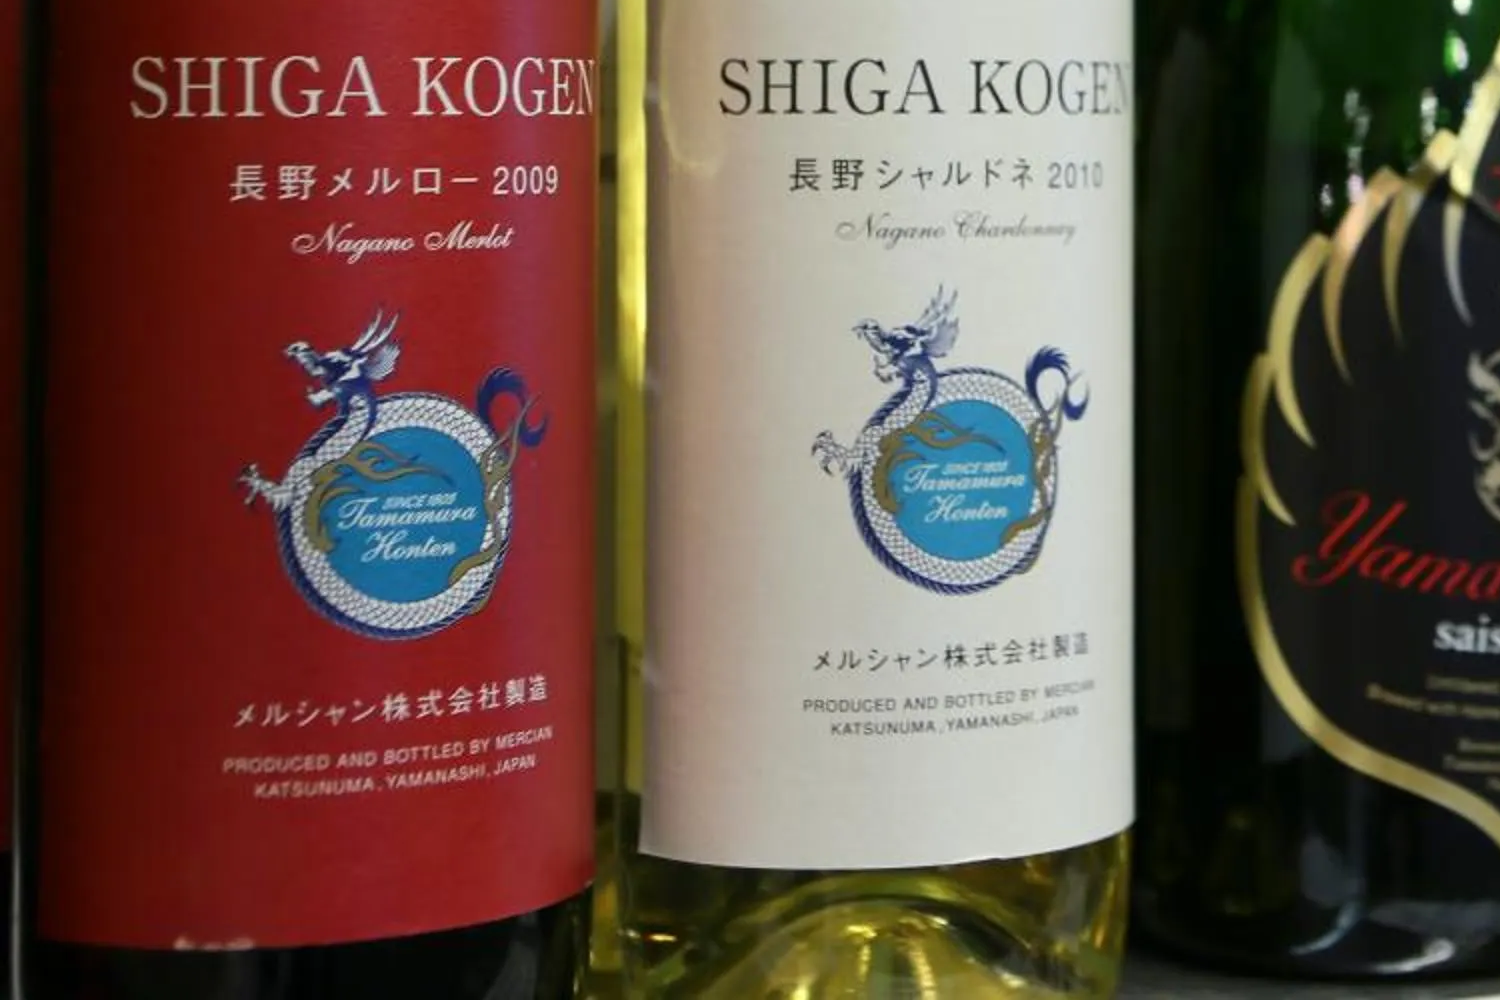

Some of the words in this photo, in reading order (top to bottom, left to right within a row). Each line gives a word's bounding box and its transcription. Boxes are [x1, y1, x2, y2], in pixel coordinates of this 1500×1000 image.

[130, 55, 386, 120] SHIGA
[412, 55, 596, 117] KOGEN
[718, 57, 949, 117] SHIGA
[968, 58, 1132, 117] KOGEN
[229, 163, 480, 202] 長野メルロー
[492, 165, 560, 197] 2009
[788, 157, 1035, 193] 長野シャルドネ
[1046, 160, 1104, 191] 2010
[290, 222, 415, 265] Nagano
[423, 220, 516, 253] Merlot
[835, 212, 946, 250] Nagano
[953, 209, 1078, 246] Chardonnay
[902, 464, 1026, 494] Tamamura
[336, 497, 477, 530] Tamamura
[924, 493, 1009, 523] Honten
[360, 529, 456, 562] Honten
[813, 632, 1089, 671] メルシャン株式会社製造
[232, 674, 548, 727] メルシャン株式会社製造
[802, 698, 896, 714] PRODUCED
[902, 695, 939, 712] AND
[944, 690, 1016, 710] BOTTLED
[1020, 687, 1040, 701] BY
[222, 753, 330, 775] PRODUCED
[336, 751, 378, 769] AND
[383, 740, 466, 765] BOTTLED
[468, 737, 491, 756] BY
[494, 725, 555, 749] MERCIAN
[493, 753, 537, 777] JAPAN
